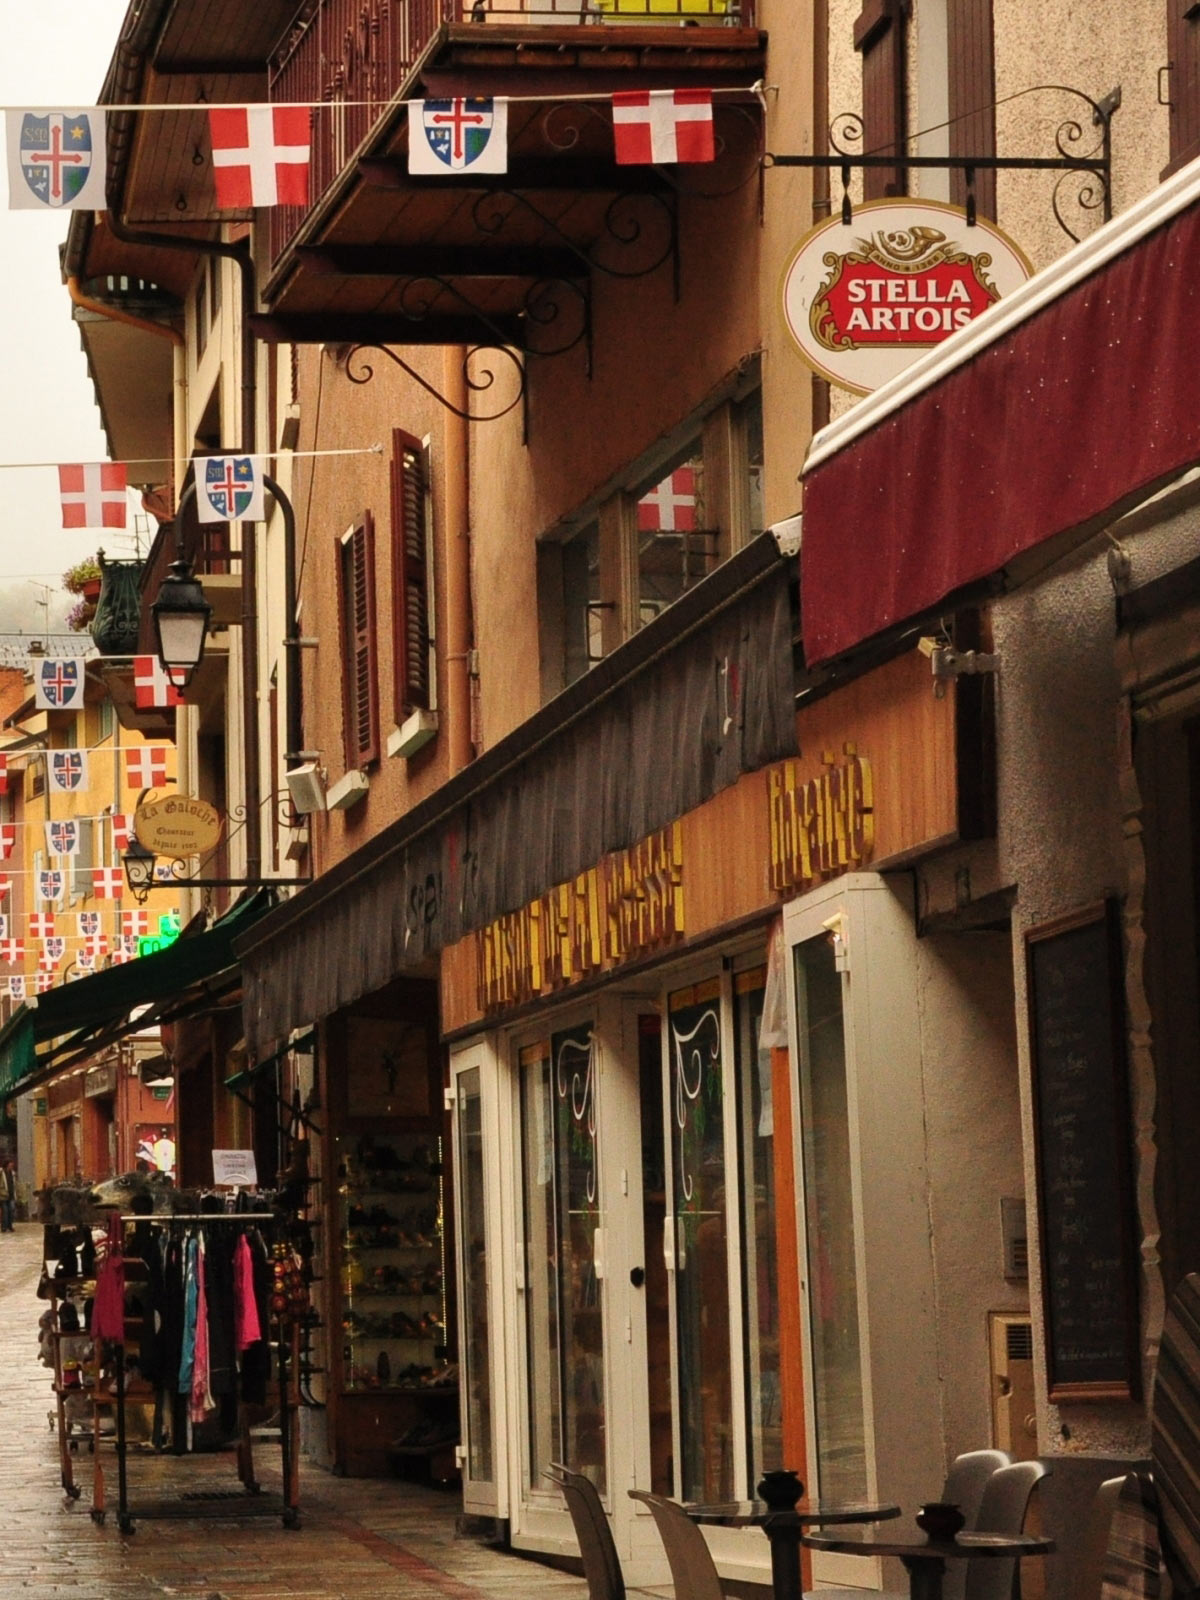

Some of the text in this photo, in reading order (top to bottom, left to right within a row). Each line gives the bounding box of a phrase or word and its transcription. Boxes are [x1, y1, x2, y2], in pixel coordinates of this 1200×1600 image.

[872, 253, 901, 272] ANNO
[847, 279, 971, 303] STELLA
[846, 307, 973, 331] ARTOIS
